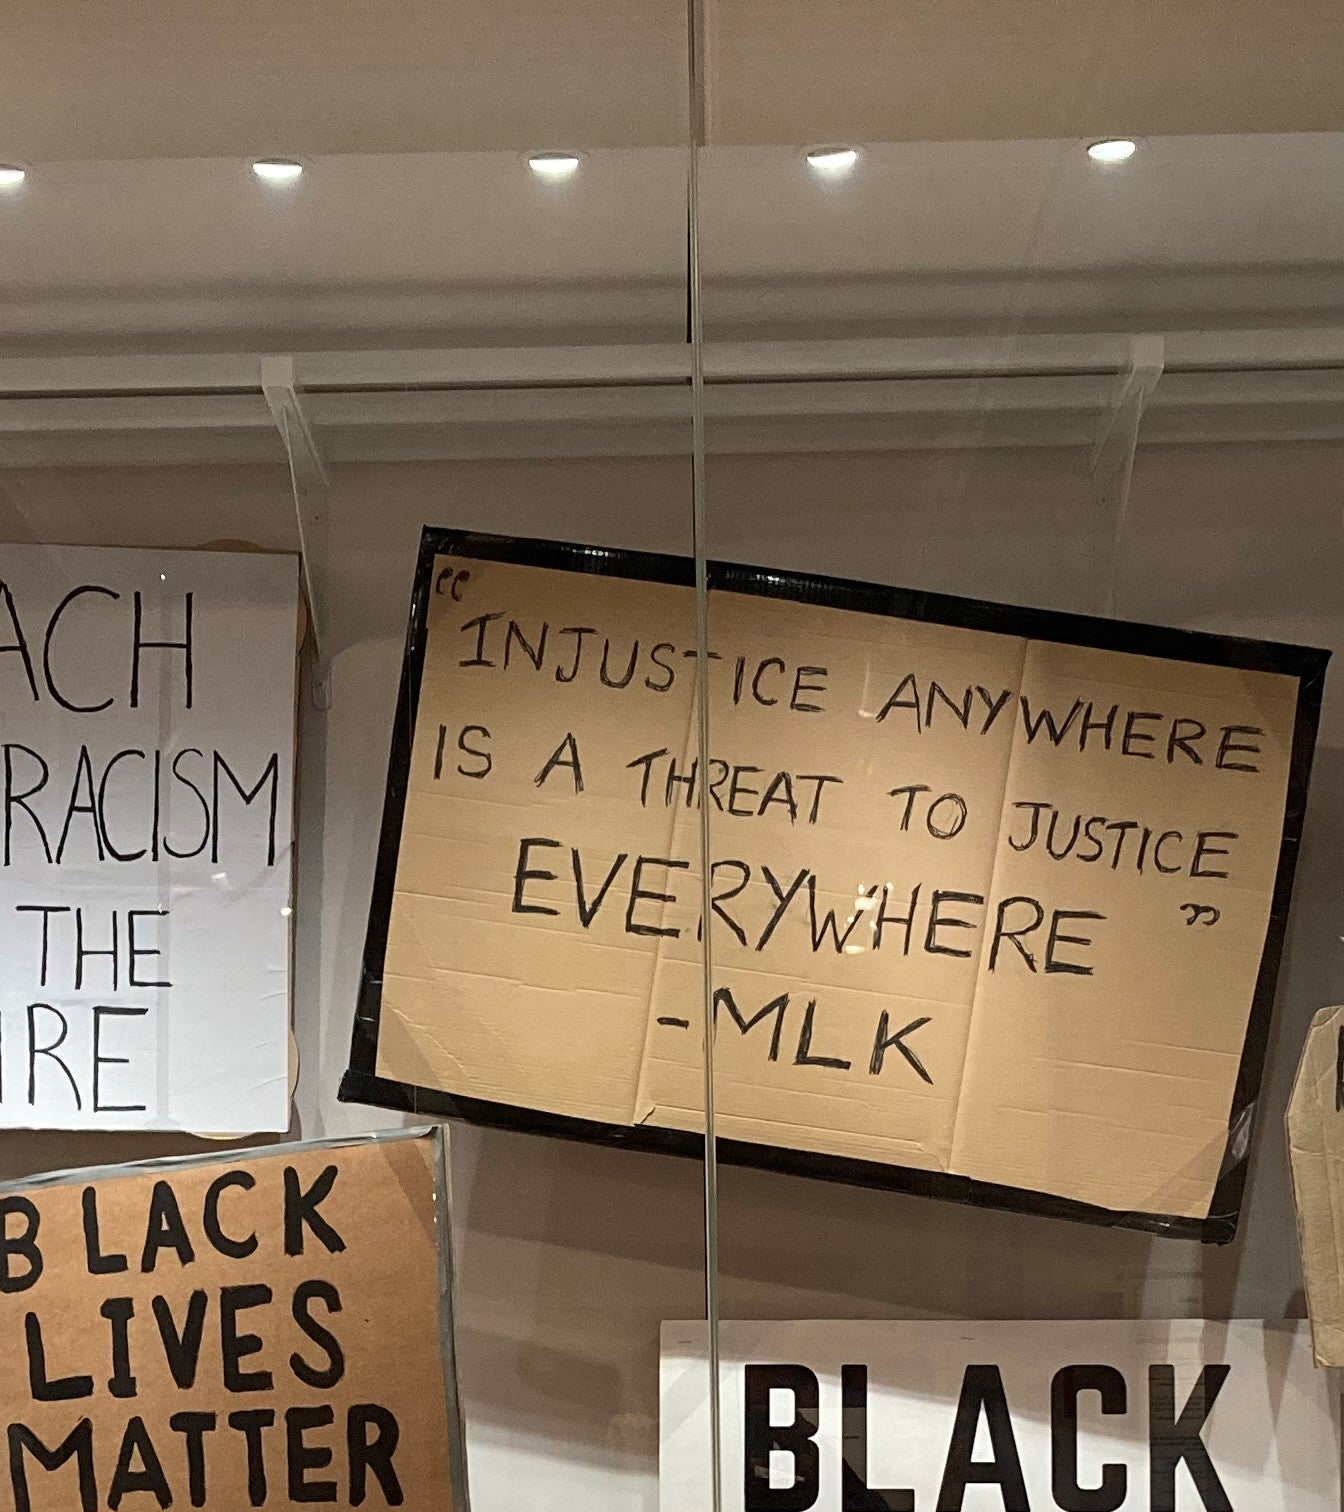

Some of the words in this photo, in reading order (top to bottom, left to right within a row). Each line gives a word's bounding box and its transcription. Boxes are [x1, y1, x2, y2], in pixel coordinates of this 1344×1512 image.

[876, 672, 1265, 773] ANYWHERE
[434, 723, 492, 779] IS
[535, 732, 584, 794] A
[625, 748, 842, 825] THREAT
[889, 784, 968, 840] TO
[1012, 800, 1239, 880] JUSTICE
[16, 905, 173, 991] THE
[511, 837, 1108, 976] EVERYWHERE
[25, 1280, 345, 1400] LIVES
